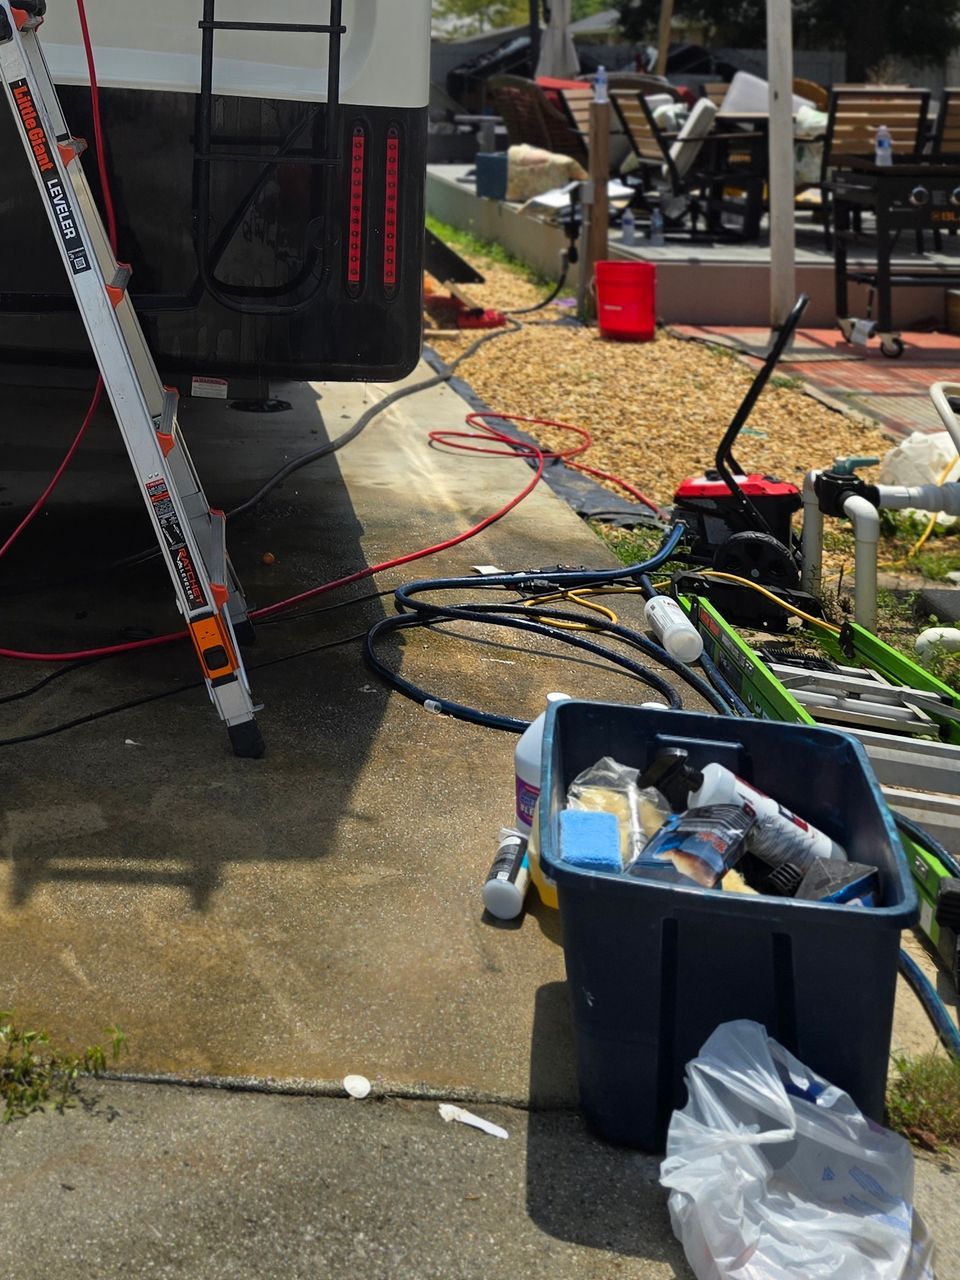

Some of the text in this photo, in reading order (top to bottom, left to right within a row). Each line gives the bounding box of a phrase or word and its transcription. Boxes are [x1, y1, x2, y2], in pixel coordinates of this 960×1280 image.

[46, 178, 76, 240] LEVELER
[178, 547, 204, 604] RATCHET
[180, 568, 194, 600] LEVELER
